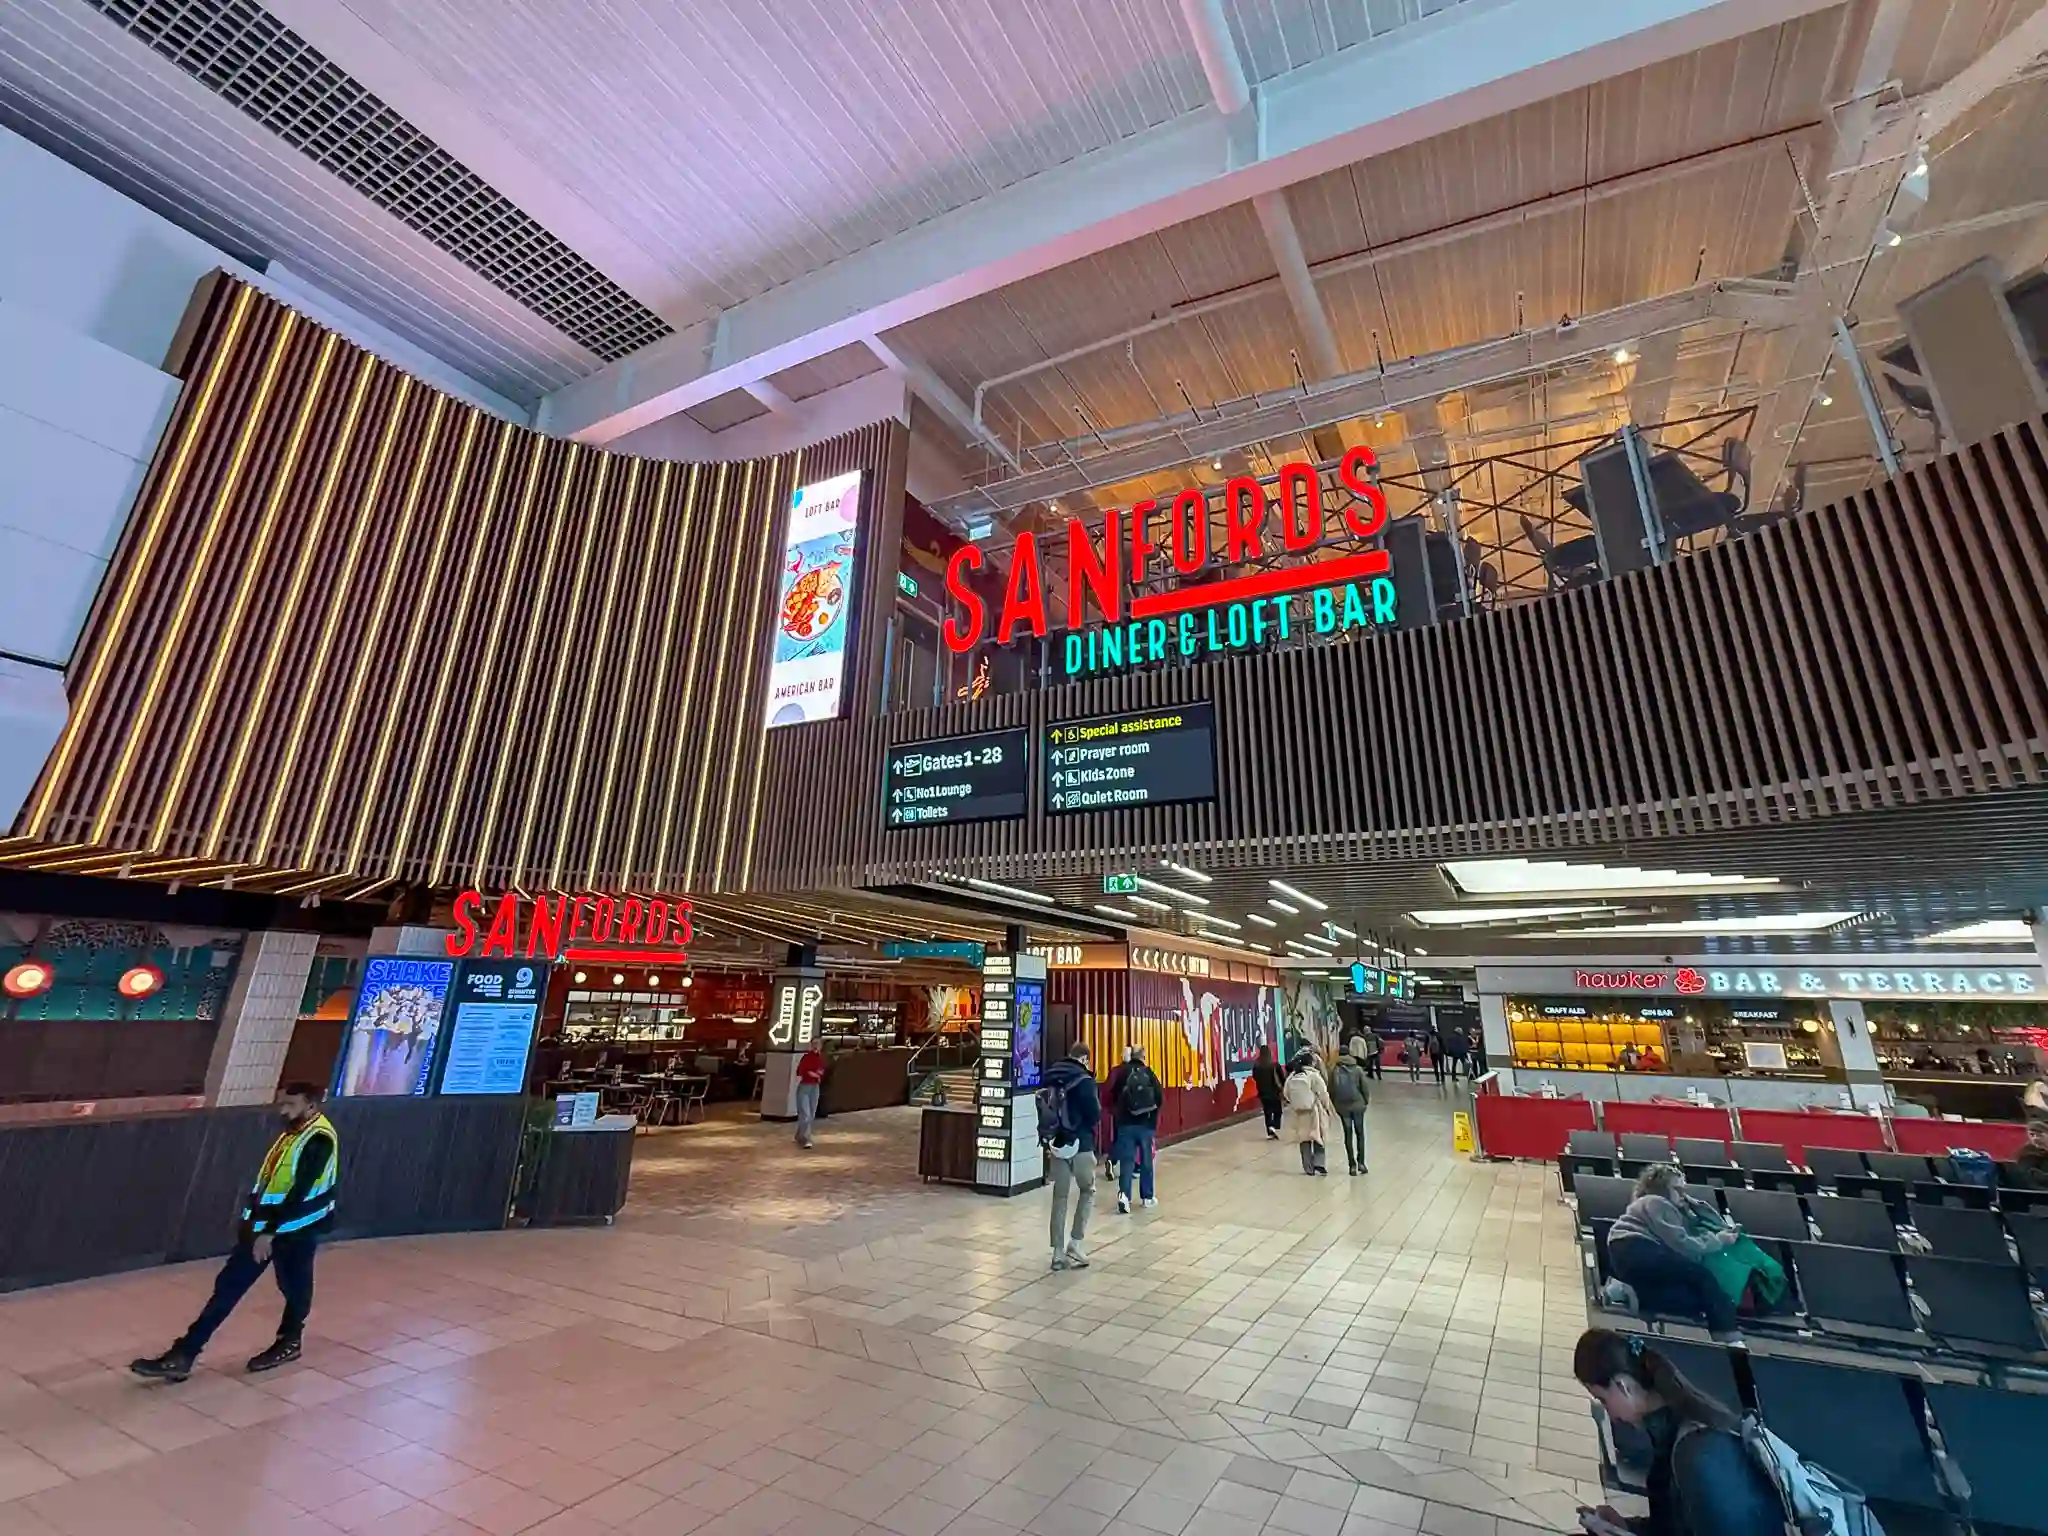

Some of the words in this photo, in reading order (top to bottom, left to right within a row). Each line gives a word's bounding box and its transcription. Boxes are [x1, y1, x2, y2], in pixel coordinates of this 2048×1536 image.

[804, 503, 823, 518] LOFT
[825, 498, 841, 512] BAR
[943, 444, 1387, 653] SANFORDS
[1065, 619, 1166, 675] DINER
[1179, 612, 1197, 656] &
[1207, 595, 1293, 652] LOFT
[1313, 577, 1396, 633] BAR
[774, 680, 816, 700] AMERICAN
[818, 677, 834, 692] BAR
[1079, 721, 1119, 741] Special
[1121, 715, 1182, 733] assistance
[922, 754, 963, 772] Gates
[963, 746, 1003, 768] 1-28
[1080, 745, 1117, 761] Prayer
[1119, 742, 1150, 756] room
[1081, 790, 1114, 805] Quiet
[1114, 787, 1148, 801] Room
[916, 805, 949, 819] Toilets
[445, 890, 693, 958] SANFORDS
[1056, 946, 1082, 965] BAR
[367, 959, 453, 982] SHAKE
[467, 974, 503, 985] FOOD
[1575, 970, 1669, 990] hawker
[1710, 971, 1782, 993] BAR
[1799, 972, 1826, 992] &
[1838, 972, 2035, 994] TERRACE
[1544, 1006, 1567, 1015] CRAFT
[1568, 1007, 1586, 1015] ALES
[1640, 1008, 1656, 1016] GIN
[1657, 1009, 1674, 1017] BAR
[1733, 1011, 1778, 1019] BREAKFAST
